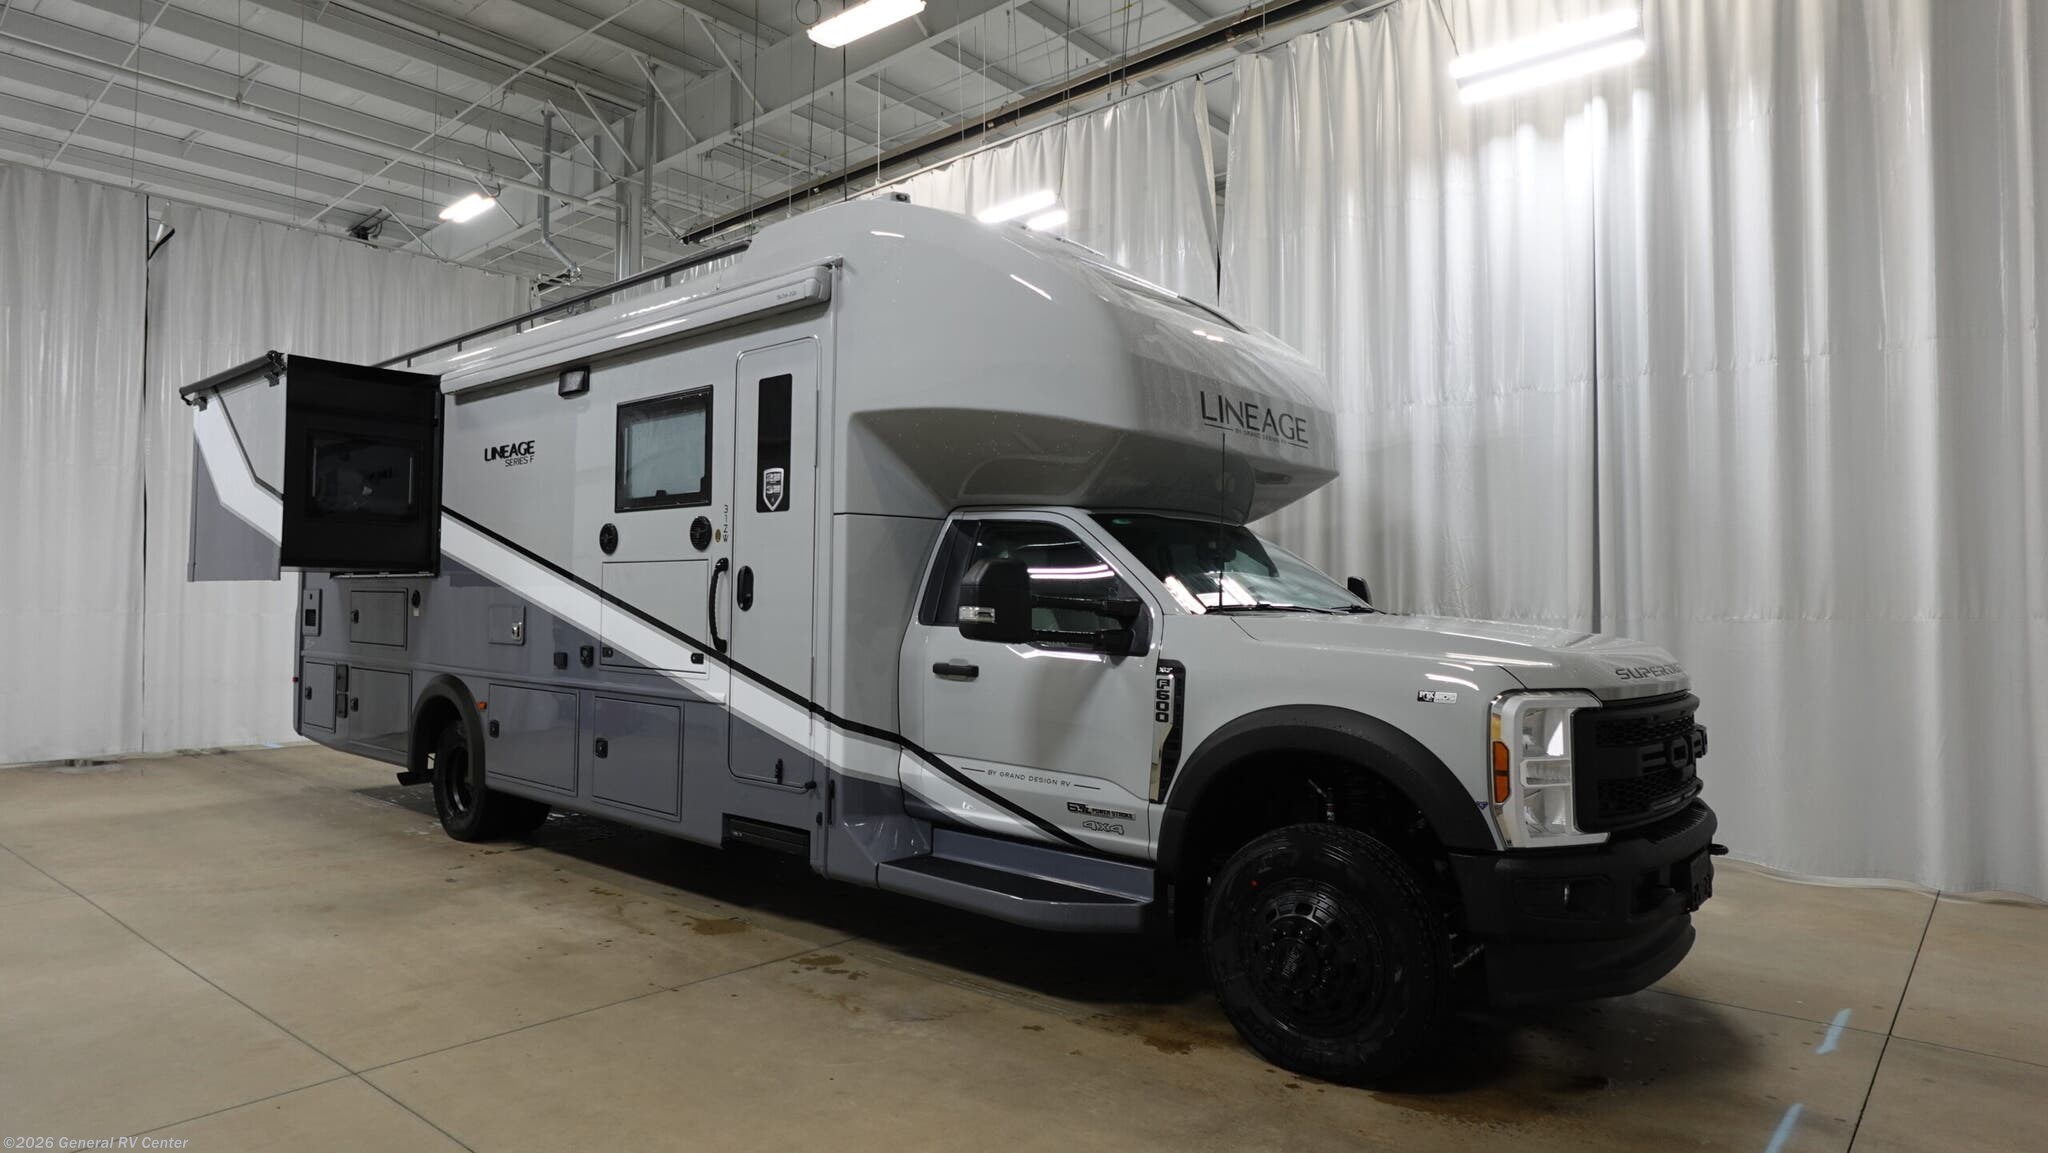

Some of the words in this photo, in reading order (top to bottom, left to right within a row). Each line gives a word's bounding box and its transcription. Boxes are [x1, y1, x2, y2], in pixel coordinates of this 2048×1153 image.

[1200, 391, 1309, 444] LINEAGE
[484, 440, 536, 462] LINEAGE
[504, 456, 529, 467] SERIES
[999, 771, 1026, 781] GRAND
[1028, 775, 1058, 785] DESIGN
